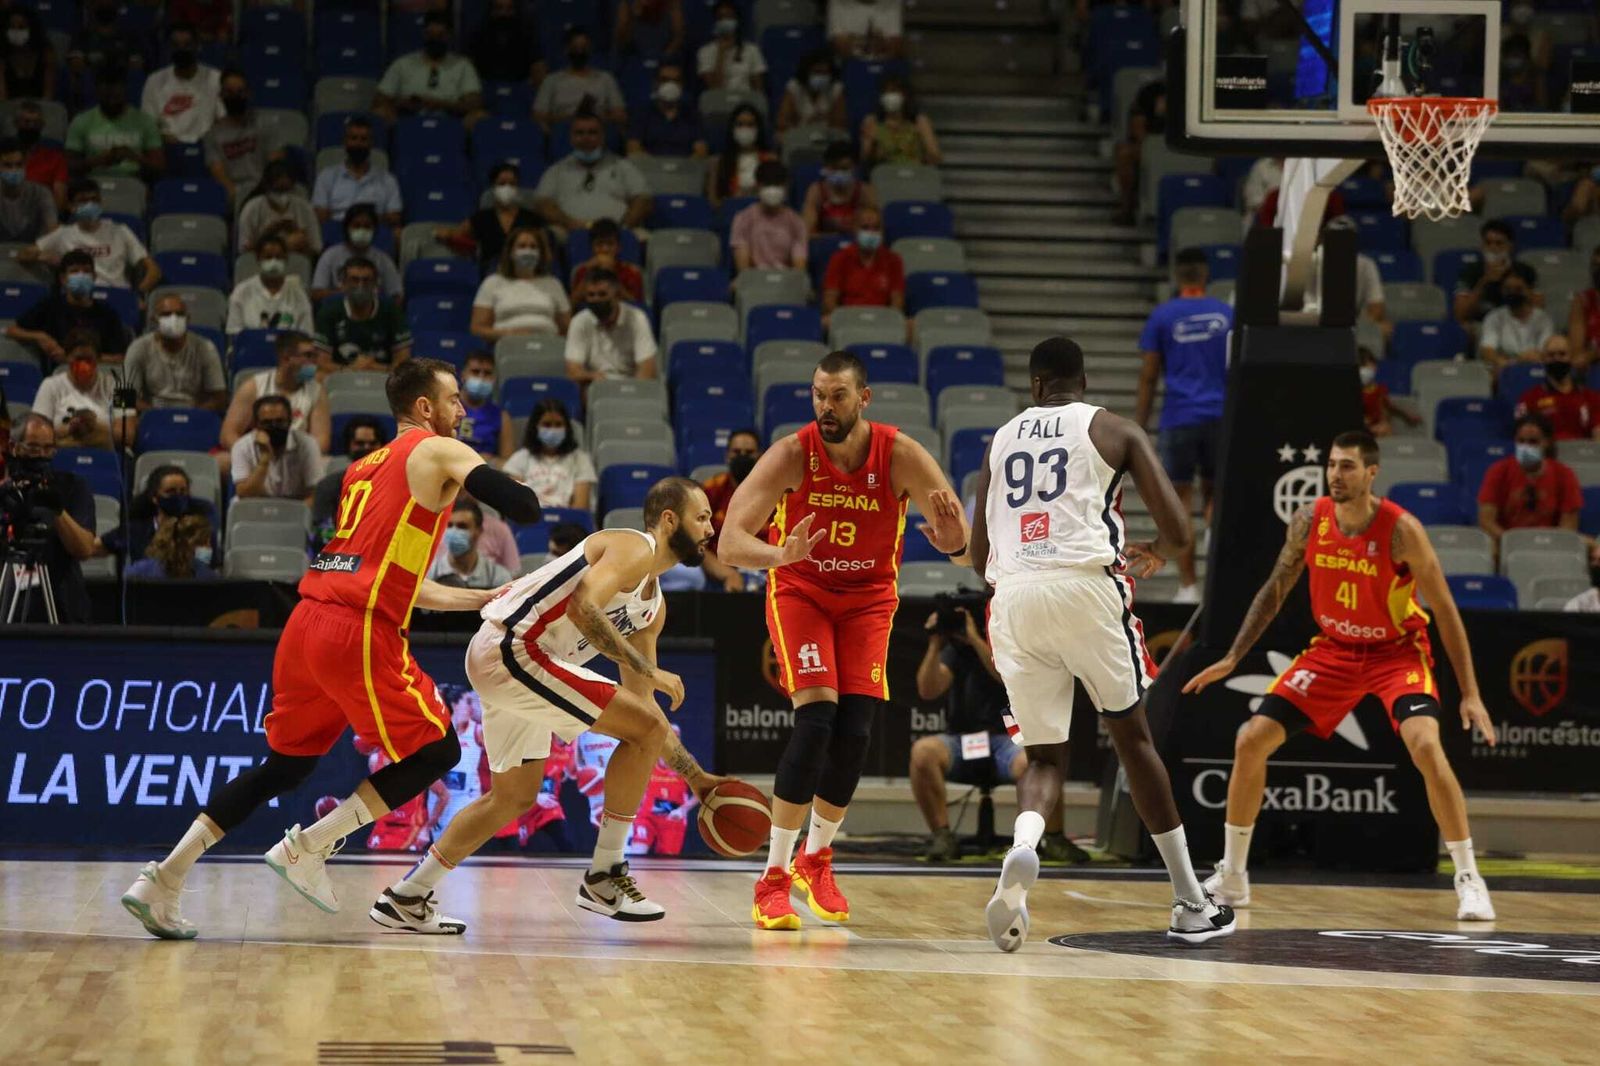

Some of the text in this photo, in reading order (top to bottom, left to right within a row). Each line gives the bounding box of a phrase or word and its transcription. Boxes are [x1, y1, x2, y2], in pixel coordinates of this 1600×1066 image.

[1017, 417, 1065, 439] FALL
[1004, 447, 1069, 509] 93
[808, 492, 880, 512] ESPAÑA
[829, 520, 857, 547] 13
[1315, 553, 1378, 577] ESPAÑA
[1335, 580, 1358, 611] 41
[1320, 614, 1387, 639] endesa
[76, 679, 270, 733] OFICIAL
[8, 752, 78, 804] LA
[1192, 769, 1398, 814] CxaBank
